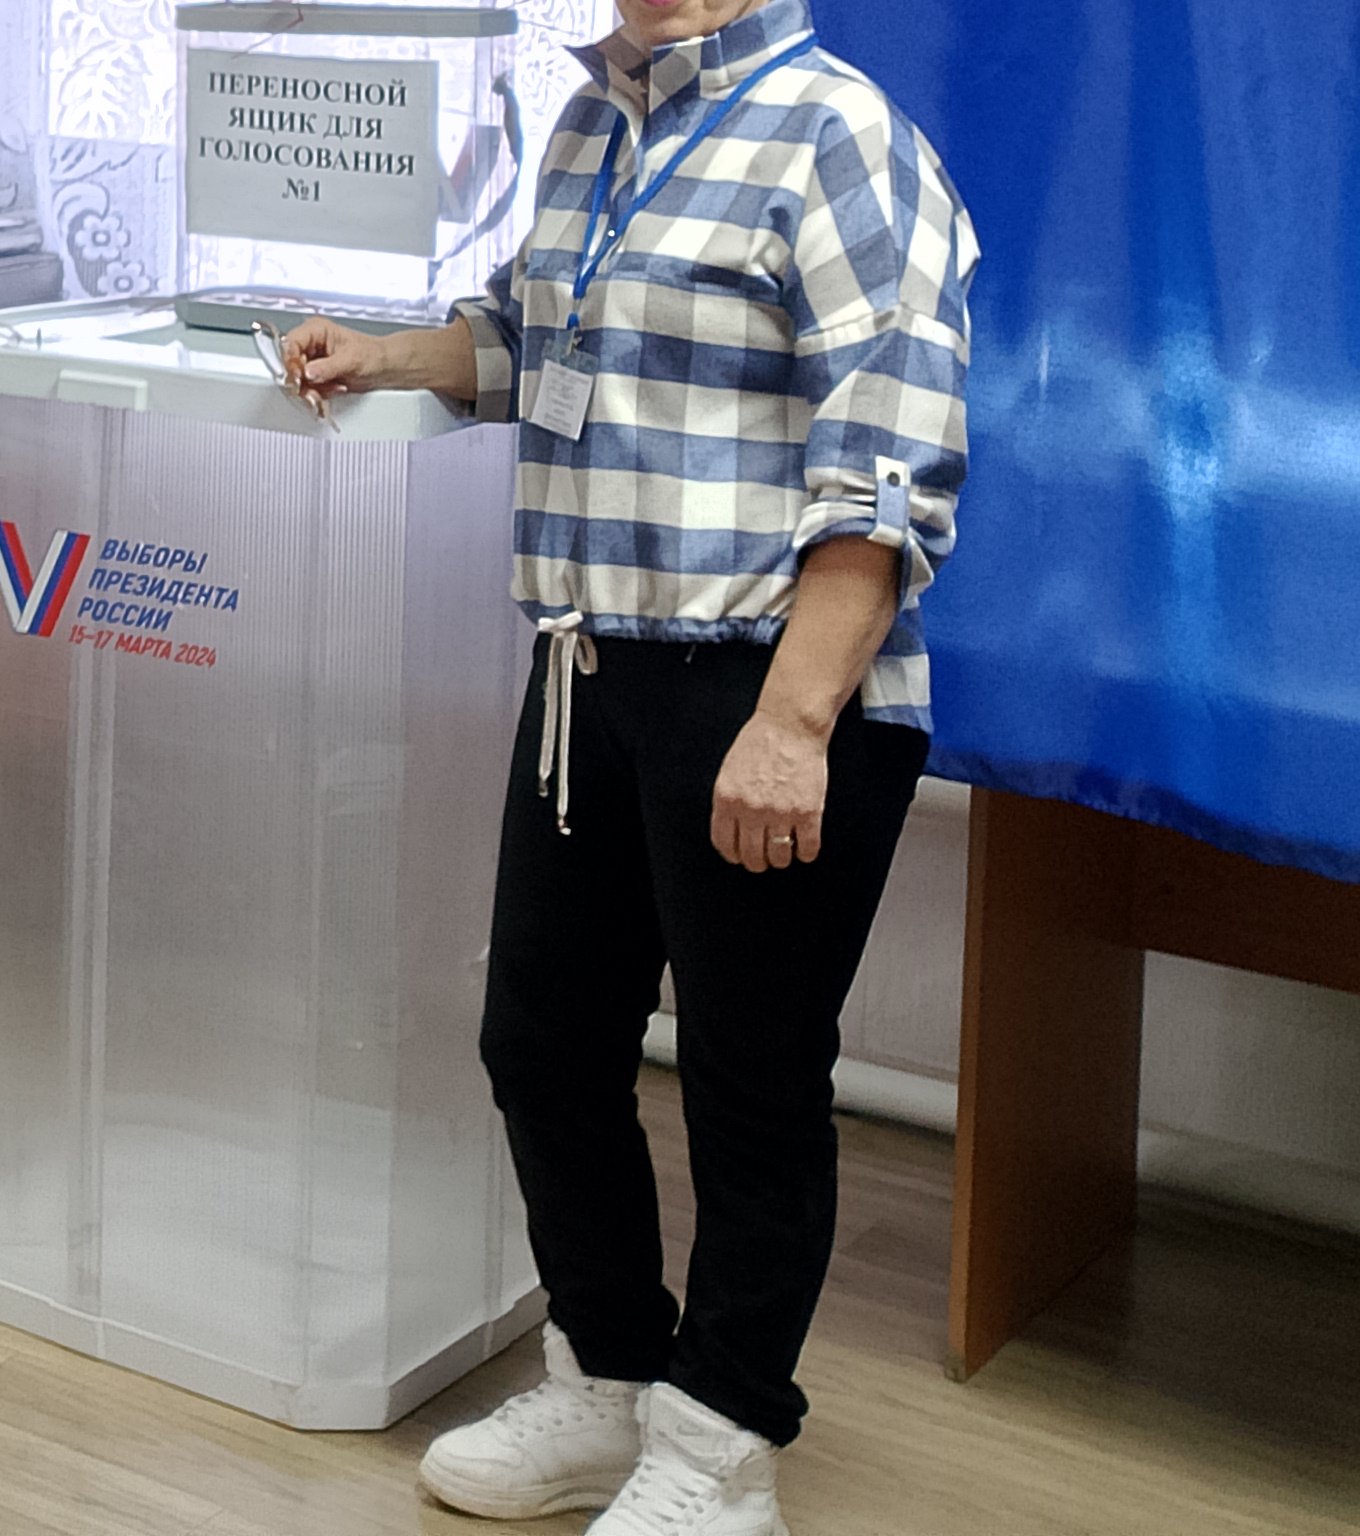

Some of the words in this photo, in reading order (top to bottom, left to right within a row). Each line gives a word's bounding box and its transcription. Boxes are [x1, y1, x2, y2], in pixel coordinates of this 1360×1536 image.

[207, 70, 408, 107] ПЕРЕНОСНОЙ
[228, 106, 317, 135] ЯЩИК
[322, 113, 383, 140] ДЛЯ
[198, 136, 415, 177] ГОЛОСОВАНИЯ
[281, 177, 322, 202] №1
[99, 538, 208, 574] ВЫБОРЫ
[88, 567, 240, 612] ПРЕЗИДЕНТА
[77, 596, 173, 633] РОССИИ
[114, 634, 173, 660] МАРТА
[174, 643, 218, 669] 2024
